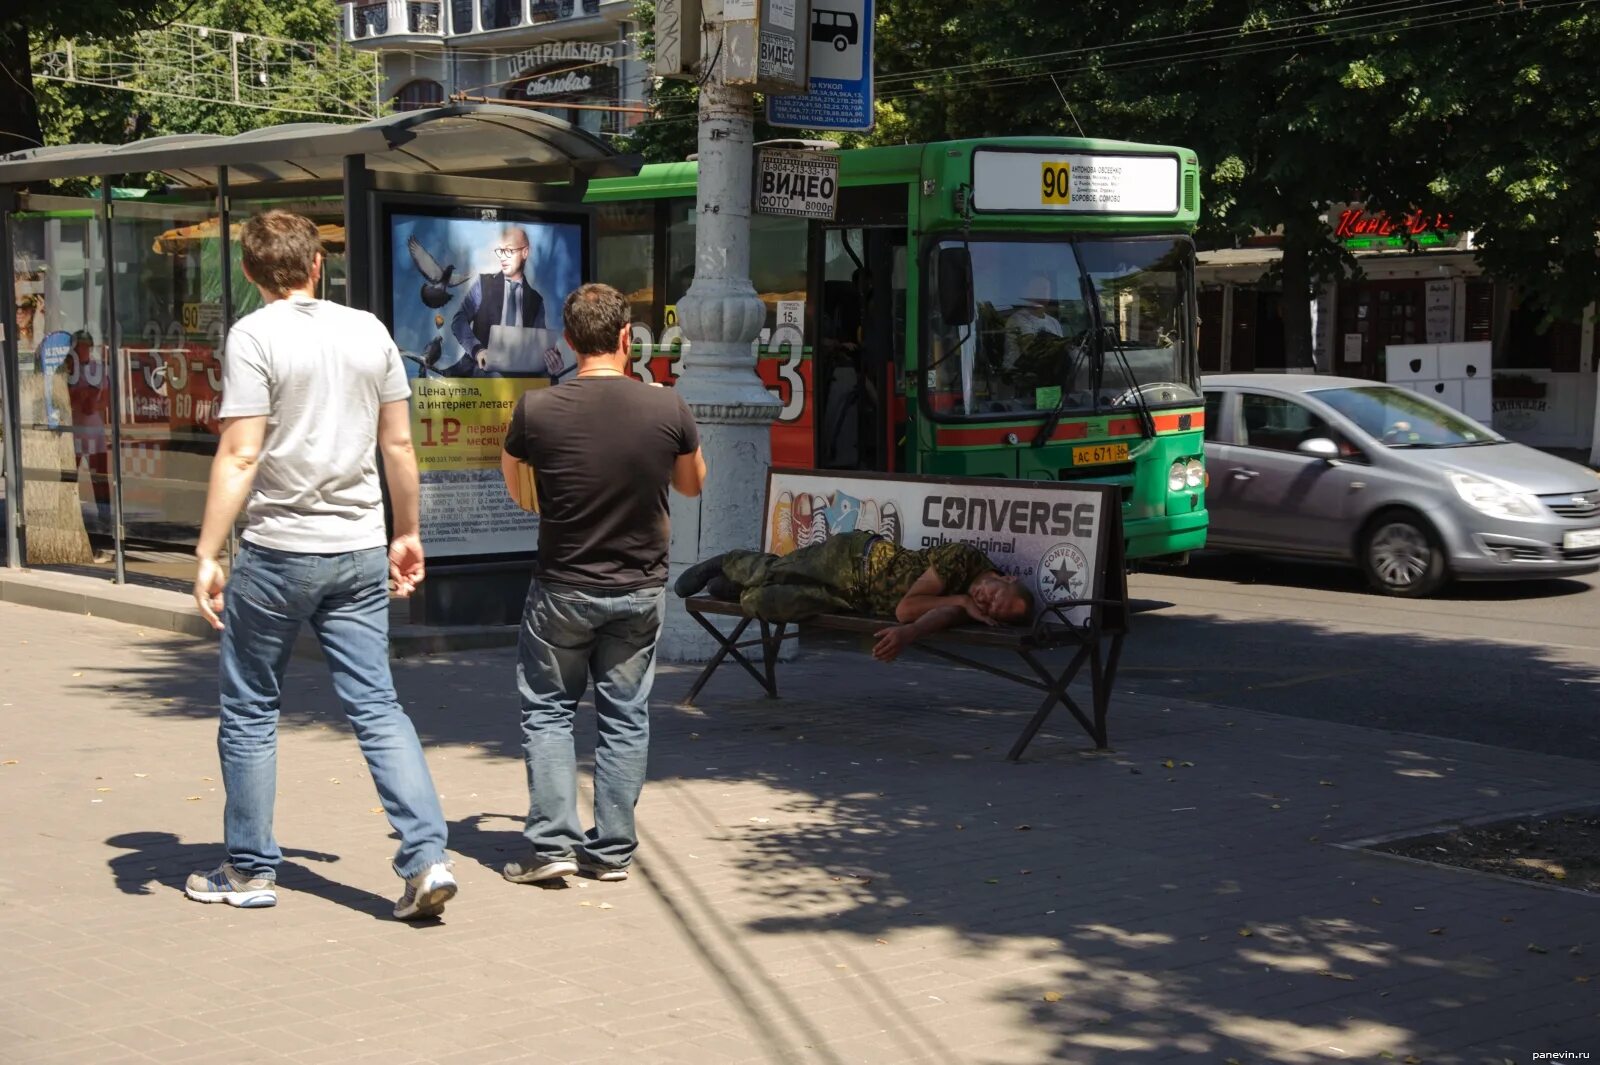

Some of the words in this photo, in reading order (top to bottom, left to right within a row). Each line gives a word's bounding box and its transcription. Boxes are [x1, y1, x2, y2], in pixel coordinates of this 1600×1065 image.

[507, 41, 614, 78] ЦЕНТРАЛЬНАЯ
[761, 43, 795, 67] ВИДЕО
[765, 162, 830, 177] 8-904-213-33-13
[762, 171, 834, 202] ВИДЕО
[1042, 166, 1069, 198] 90
[761, 195, 789, 208] ФОТО
[184, 306, 198, 329] 90
[418, 385, 446, 397] Цена
[448, 387, 482, 398] упала,
[175, 393, 192, 418] 60
[418, 401, 424, 409] а
[427, 400, 477, 411] интернет
[479, 400, 513, 409] летает
[466, 422, 507, 436] первый
[466, 437, 500, 447] месяц
[1093, 446, 1112, 461] 671
[921, 495, 1095, 538] CONVERSE
[1044, 548, 1084, 570] CONVERSE
